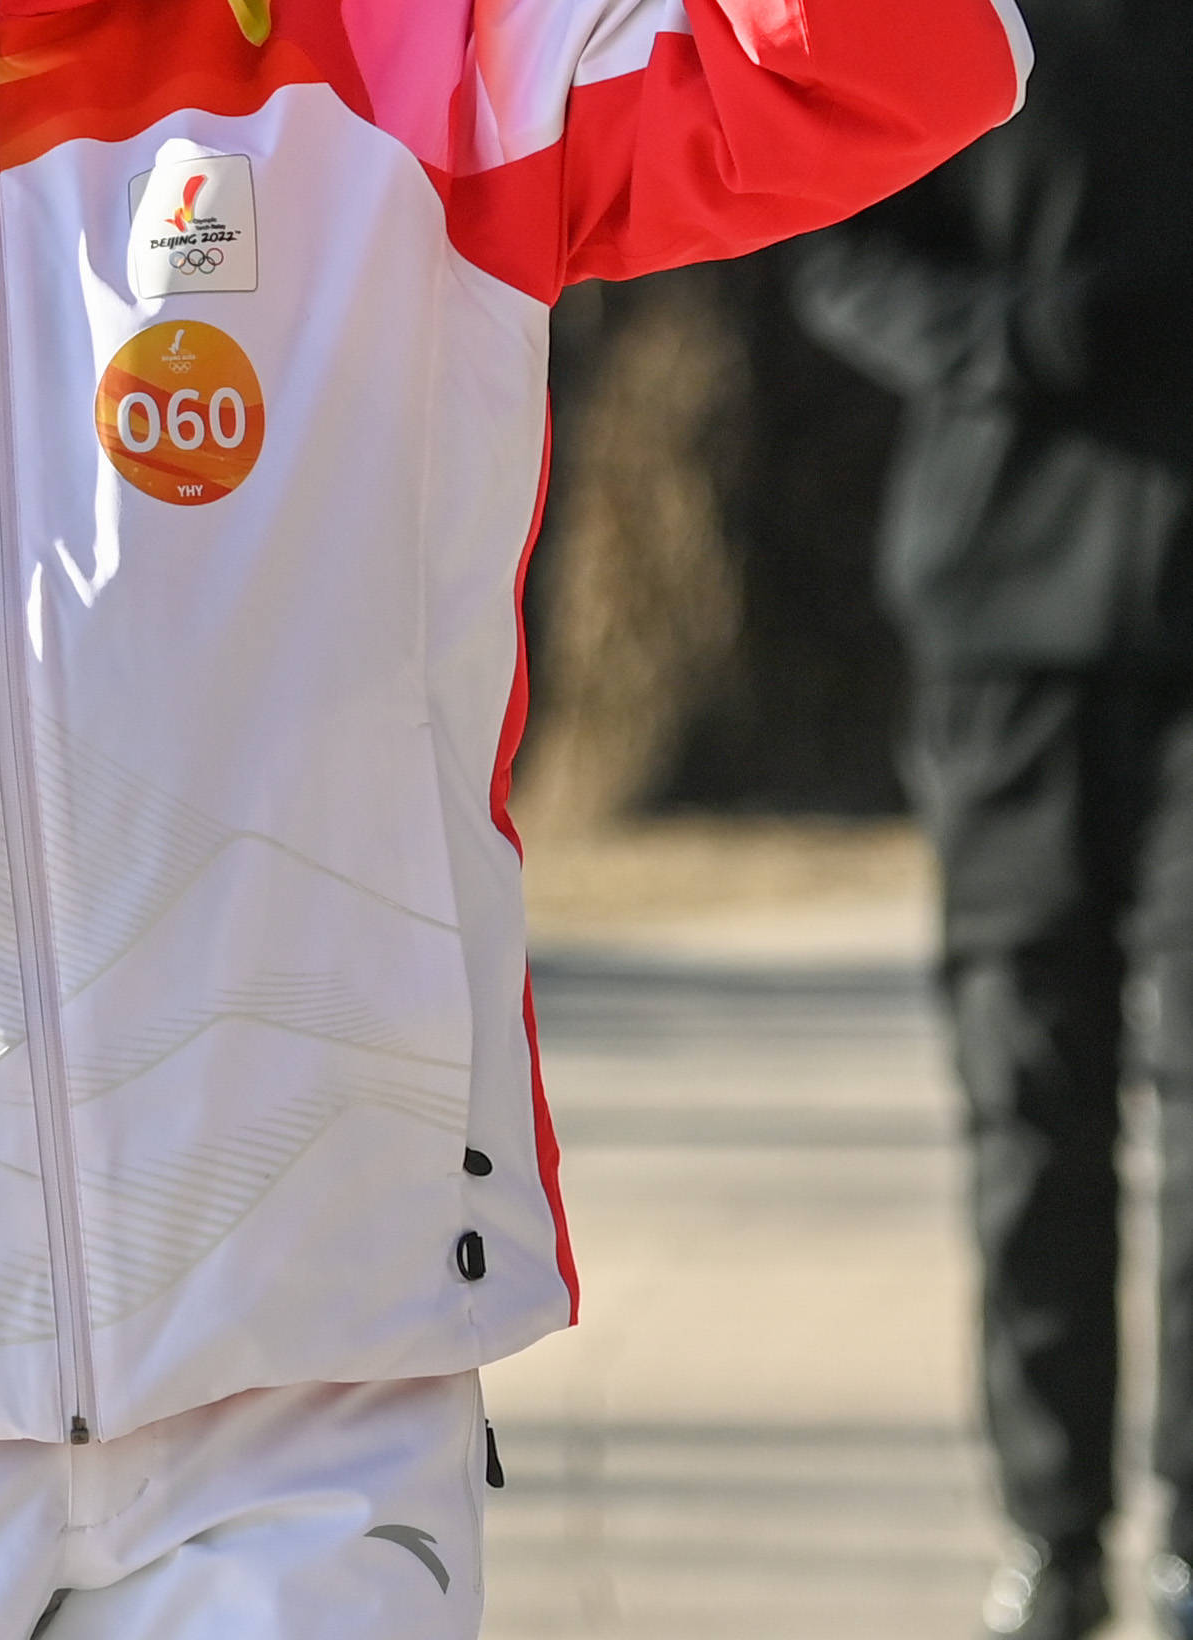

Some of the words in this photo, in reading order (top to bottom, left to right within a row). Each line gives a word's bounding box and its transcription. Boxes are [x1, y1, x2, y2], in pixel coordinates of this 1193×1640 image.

[150, 233, 197, 249] BEIJING
[117, 387, 246, 453] 060
[177, 485, 204, 497] YHY
